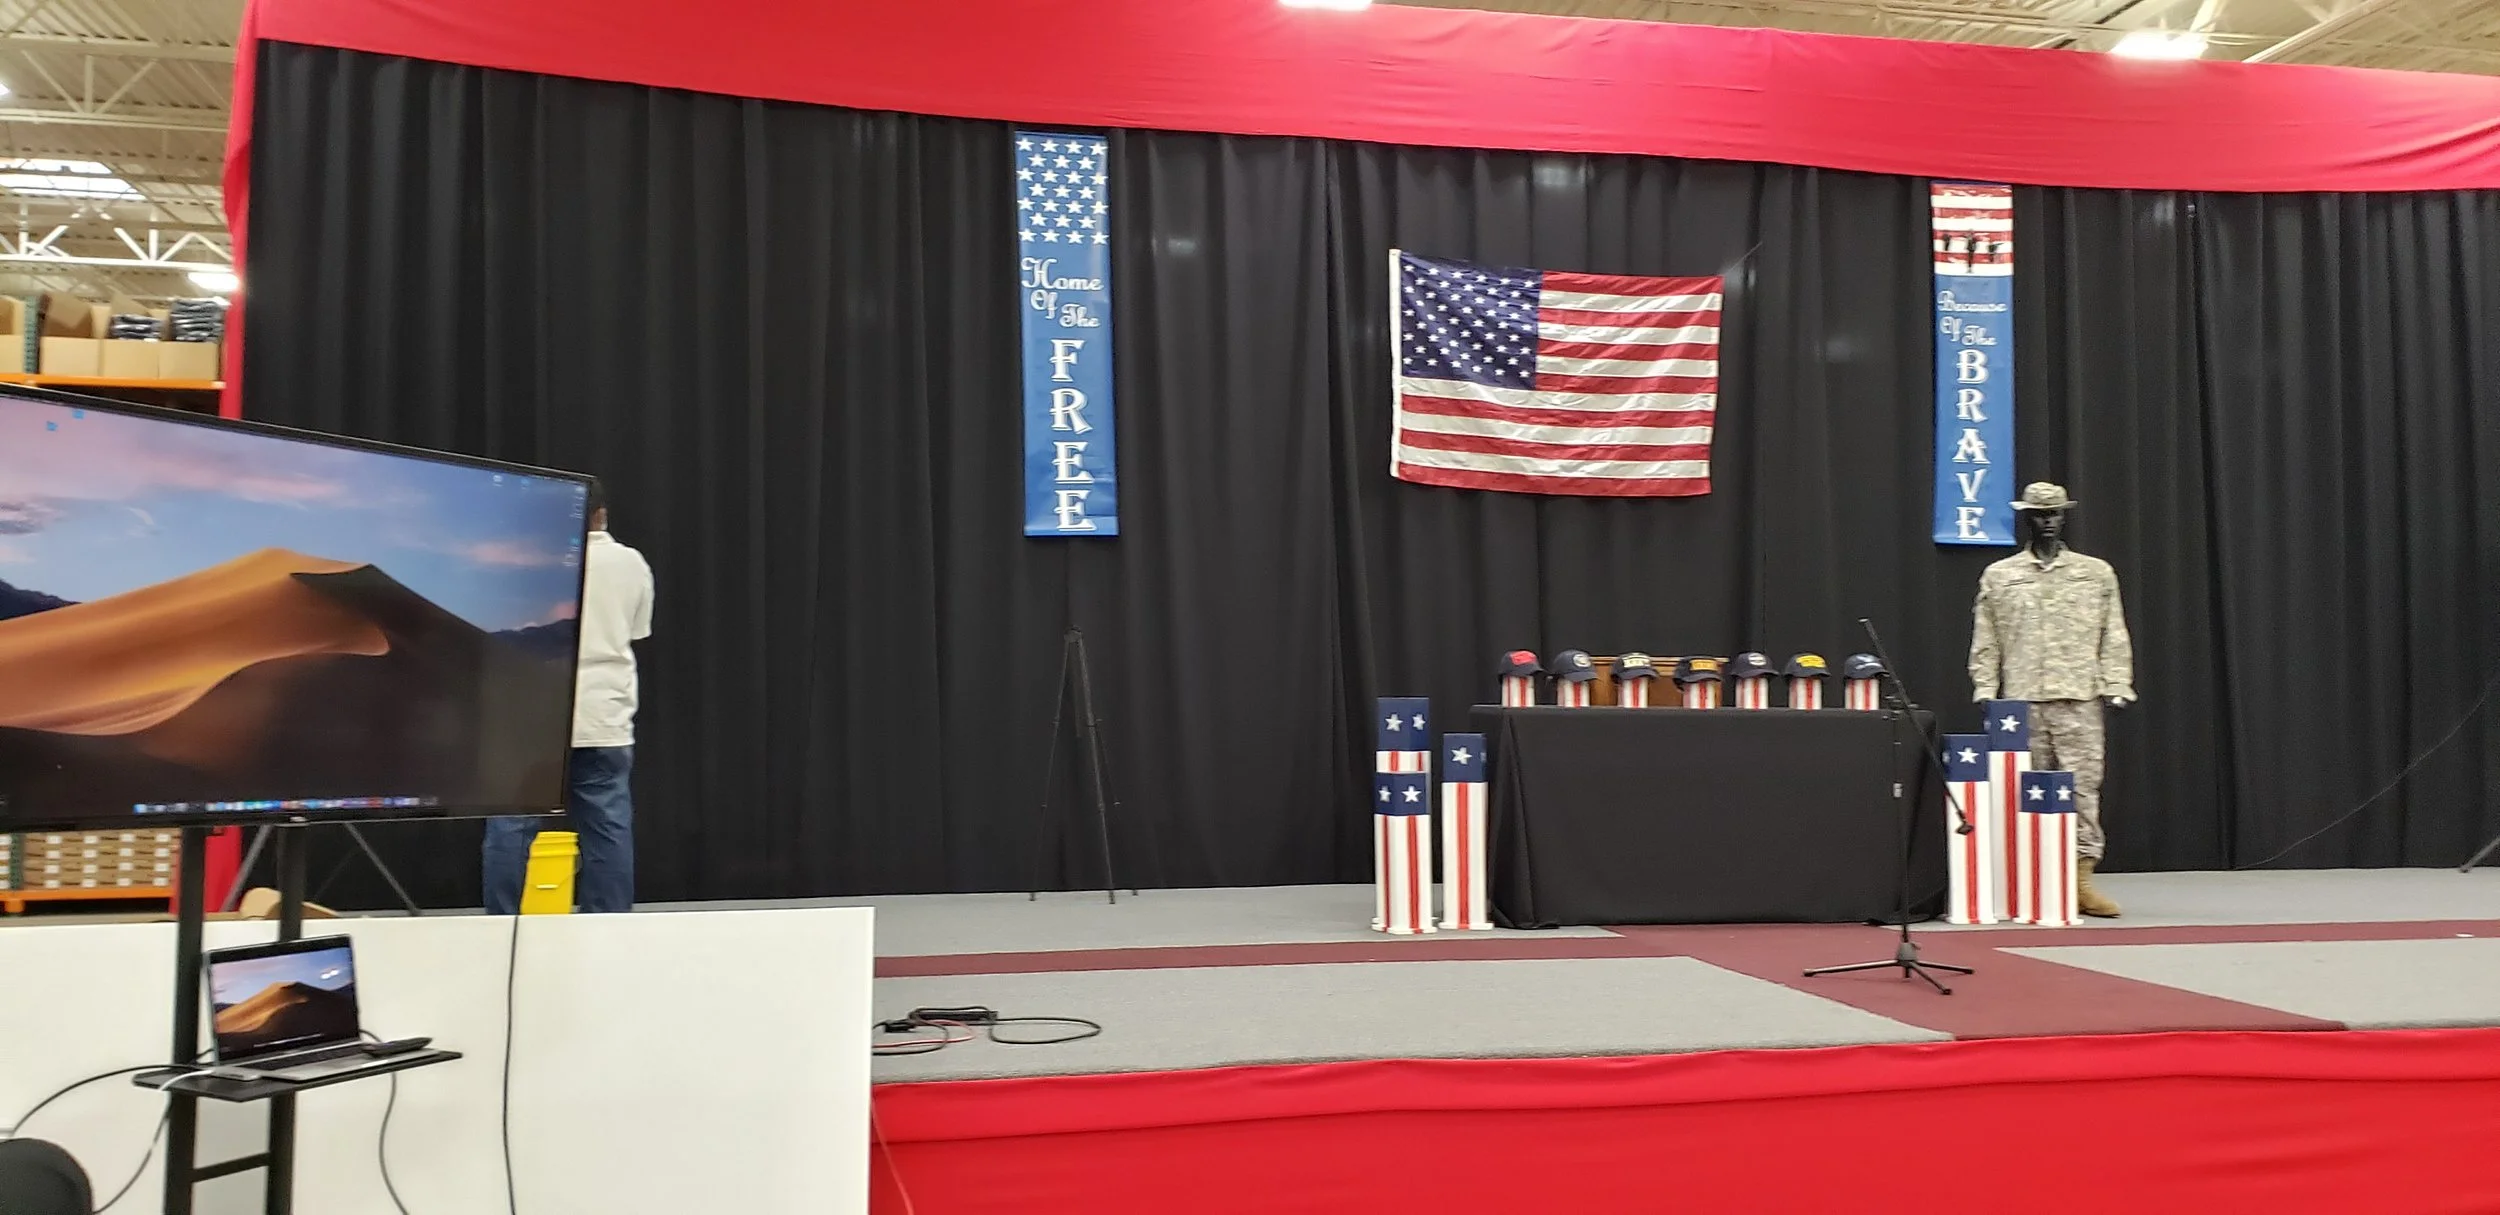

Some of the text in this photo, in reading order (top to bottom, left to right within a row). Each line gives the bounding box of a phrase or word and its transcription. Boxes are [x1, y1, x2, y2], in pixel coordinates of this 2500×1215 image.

[1021, 257, 1104, 290] Home
[1030, 289, 1101, 328] Of The
[1936, 290, 2008, 312] Because
[1940, 316, 1998, 346] Of The
[1048, 339, 1098, 532] FREE
[1952, 349, 1991, 542] BRAVE
